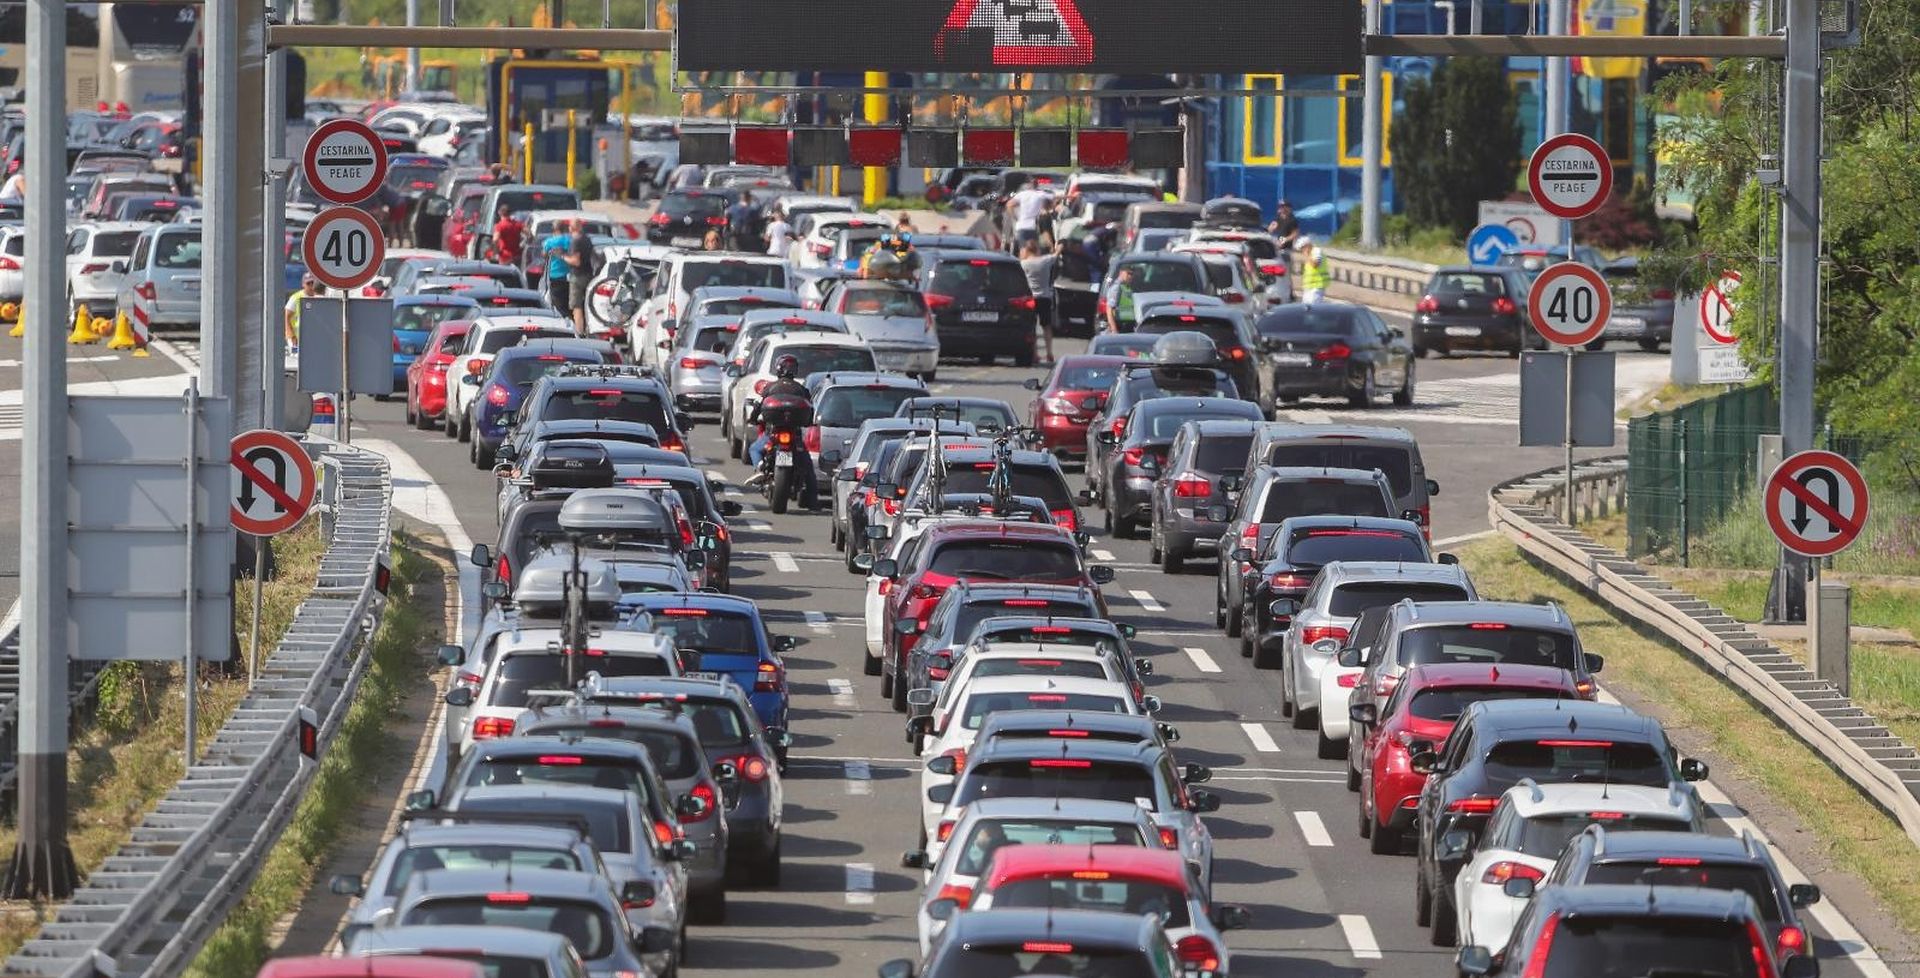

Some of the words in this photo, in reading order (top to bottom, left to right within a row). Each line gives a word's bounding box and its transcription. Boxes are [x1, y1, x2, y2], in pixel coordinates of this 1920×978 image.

[320, 145, 370, 156] CESTARINA
[1544, 160, 1595, 170] CESTARINA
[329, 168, 361, 178] PEAGE
[1553, 183, 1586, 193] PEAGE
[322, 229, 366, 267] 40
[1547, 286, 1592, 323] 40
